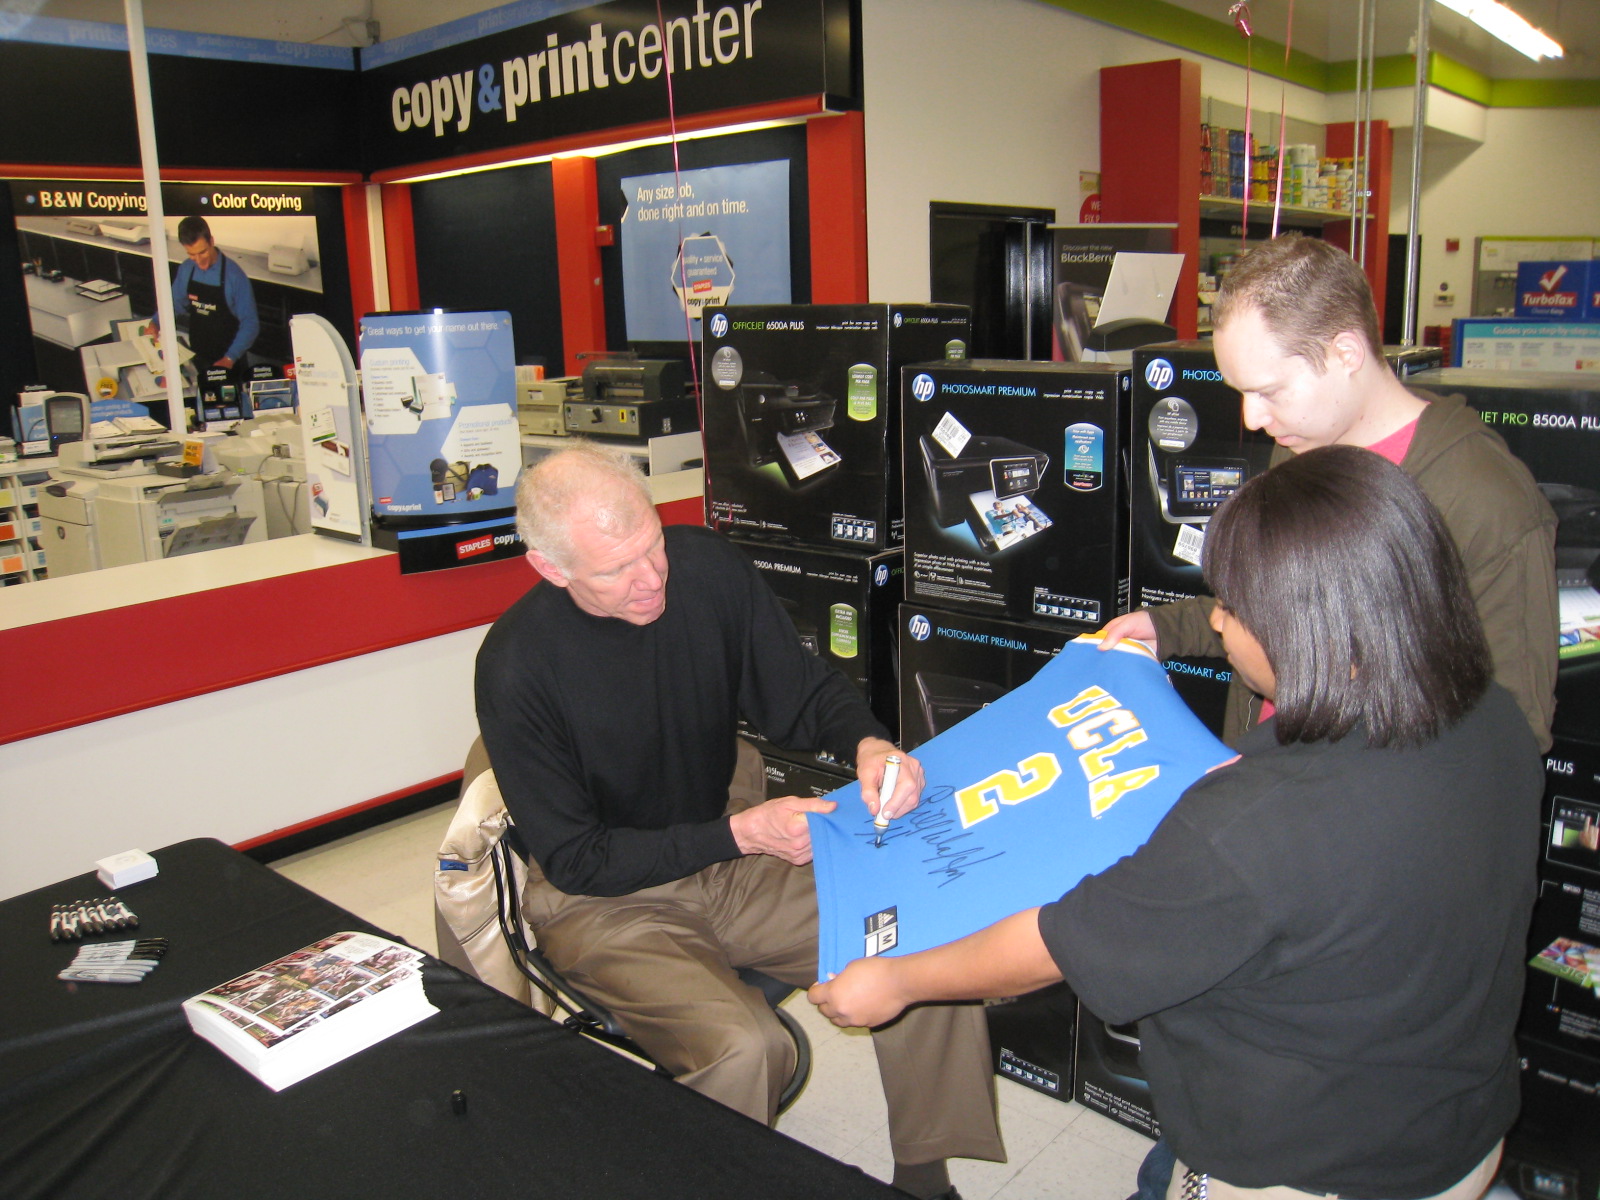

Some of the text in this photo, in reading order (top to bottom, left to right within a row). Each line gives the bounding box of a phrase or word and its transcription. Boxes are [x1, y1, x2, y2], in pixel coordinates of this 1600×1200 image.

[40, 191, 147, 211] B&W Copying
[212, 193, 302, 212] Color Copying
[637, 186, 654, 204] Any
[655, 184, 674, 200] size
[638, 198, 749, 222] done right and on time.
[1523, 292, 1574, 306] TurboTax
[368, 327, 384, 336] Great
[386, 327, 404, 336] ways
[414, 326, 426, 336] get
[468, 323, 480, 331] out
[480, 322, 499, 331] there.
[711, 314, 804, 339] hp OFFICEJET 6500A PLUS
[1493, 326, 1521, 334] Guides
[1522, 328, 1537, 336] you
[1148, 358, 1172, 390] hp
[914, 373, 1036, 402] hp PHOTOSMART PREMIUM
[1502, 412, 1528, 425] PRO
[1532, 414, 1576, 429] 8500A
[460, 538, 491, 554] STAPLES
[774, 560, 802, 574] PREMIUM
[875, 565, 888, 586] hp
[910, 614, 1028, 651] hp PHOTOSMART PREMIUM
[1047, 685, 1160, 818] UCLA
[1546, 758, 1574, 774] PLUS
[954, 752, 1062, 829] 2
[882, 932, 893, 946] M
